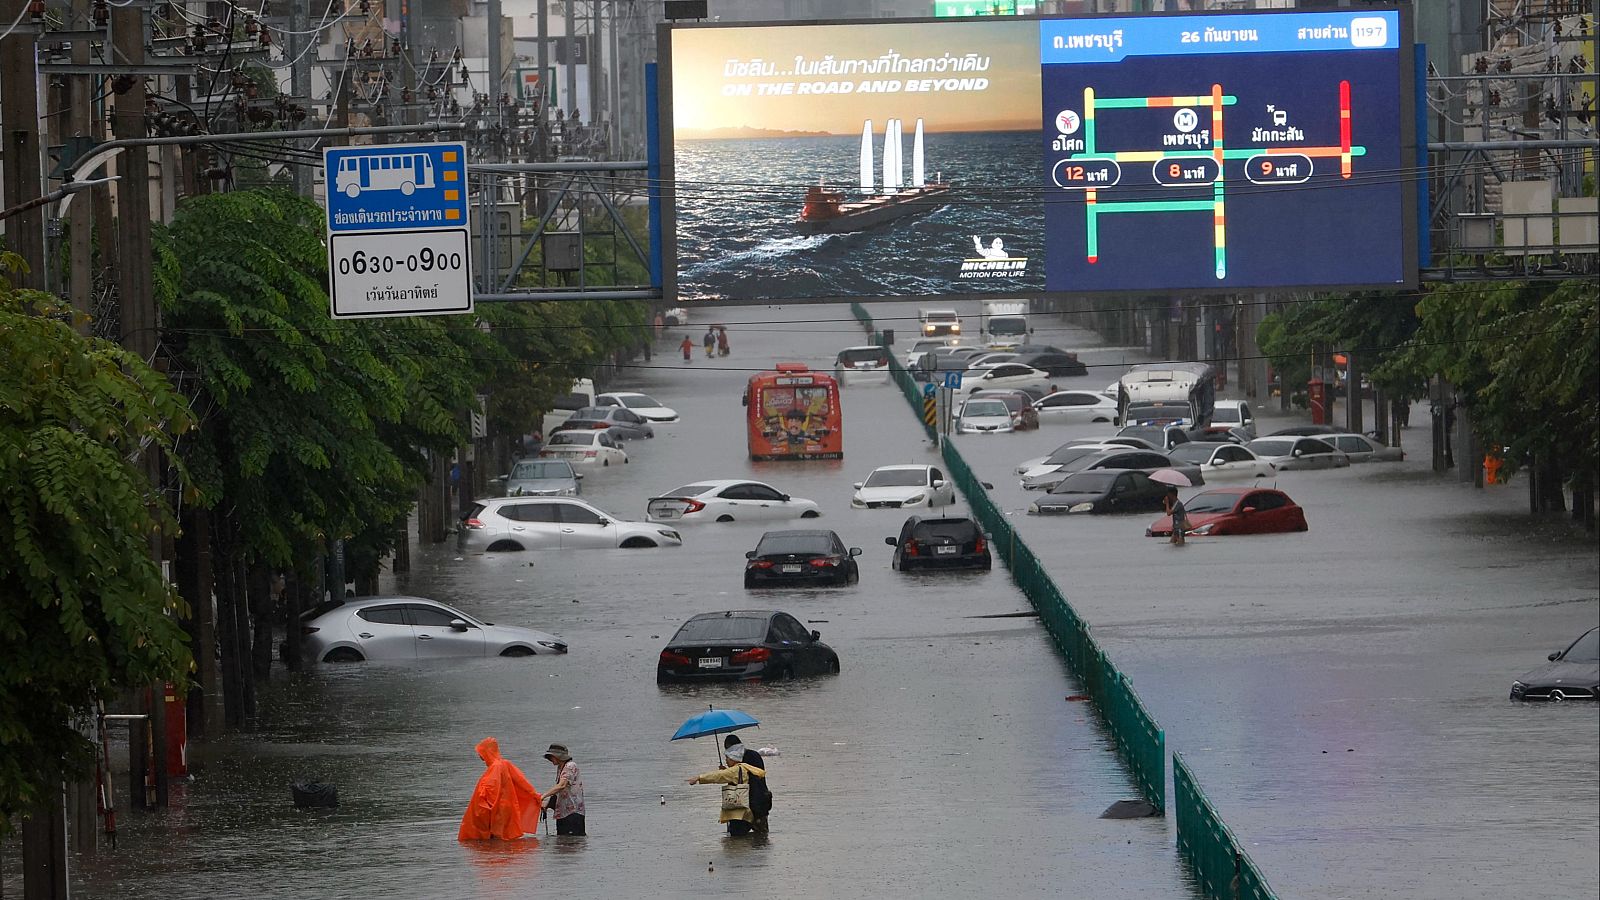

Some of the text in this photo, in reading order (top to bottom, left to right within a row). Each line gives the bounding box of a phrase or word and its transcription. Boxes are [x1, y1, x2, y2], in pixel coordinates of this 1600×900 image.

[1181, 27, 1258, 43] 26 กันยายน
[1297, 24, 1383, 40] สายด่วน 1197
[1053, 30, 1123, 53] ถ.เพชรบุรี
[723, 48, 990, 78] มิชลิน...ในเส้นทางที่ไกลกว่าเดิม
[721, 77, 989, 97] ON THE ROAD AND BEYOND
[1163, 129, 1210, 149] เพชรบุรี
[1251, 126, 1304, 142] มักกะสัน
[1052, 134, 1084, 151] อโศก
[1065, 166, 1108, 182] 12 นาที
[1169, 164, 1205, 179] 8 นาที
[1260, 161, 1297, 177] 9 นาที
[334, 206, 442, 224] ช่องเดินรถประจำทาง
[339, 247, 461, 275] 0630-0900
[961, 261, 1027, 271] MICHELIN
[959, 271, 990, 279] MOTION
[366, 284, 439, 302] เว้นวันอาทิตย์
